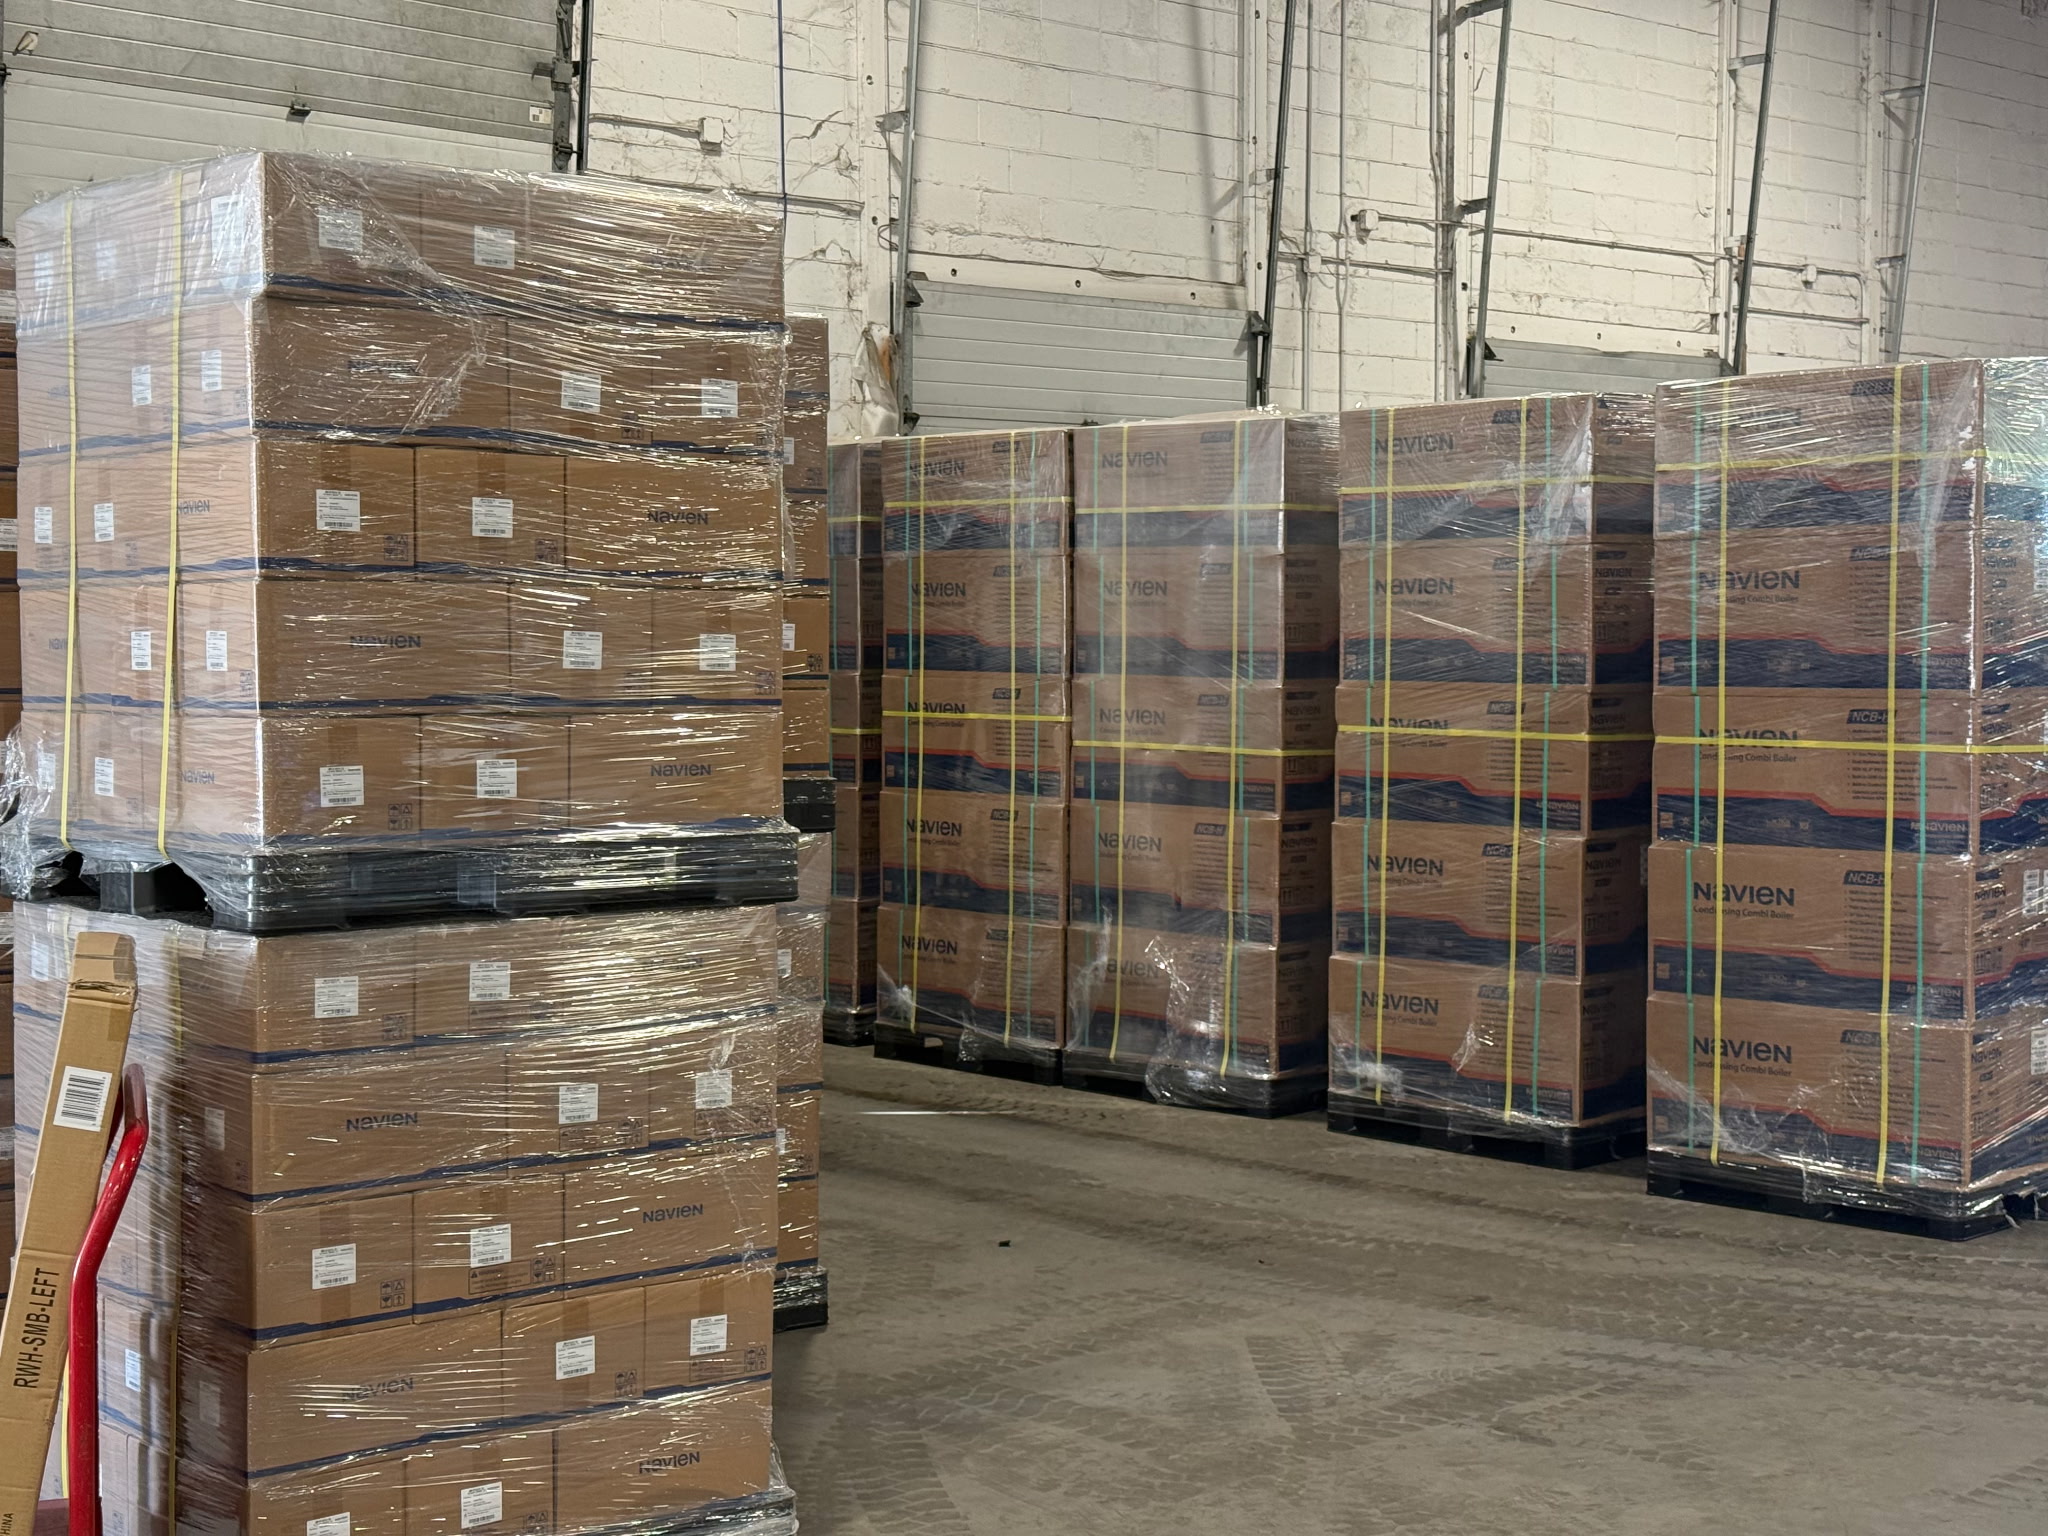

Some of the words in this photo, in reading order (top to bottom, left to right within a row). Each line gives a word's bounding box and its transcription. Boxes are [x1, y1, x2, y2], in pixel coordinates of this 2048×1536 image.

[1745, 752, 1772, 762] Combi
[1773, 753, 1797, 763] Boiler
[1742, 908, 1769, 919] Combi
[1770, 910, 1794, 920] Boiler
[1741, 1063, 1767, 1076] Combi
[1768, 1066, 1793, 1078] Boiler
[13, 1267, 60, 1389] RWH-SMB-LEFT
